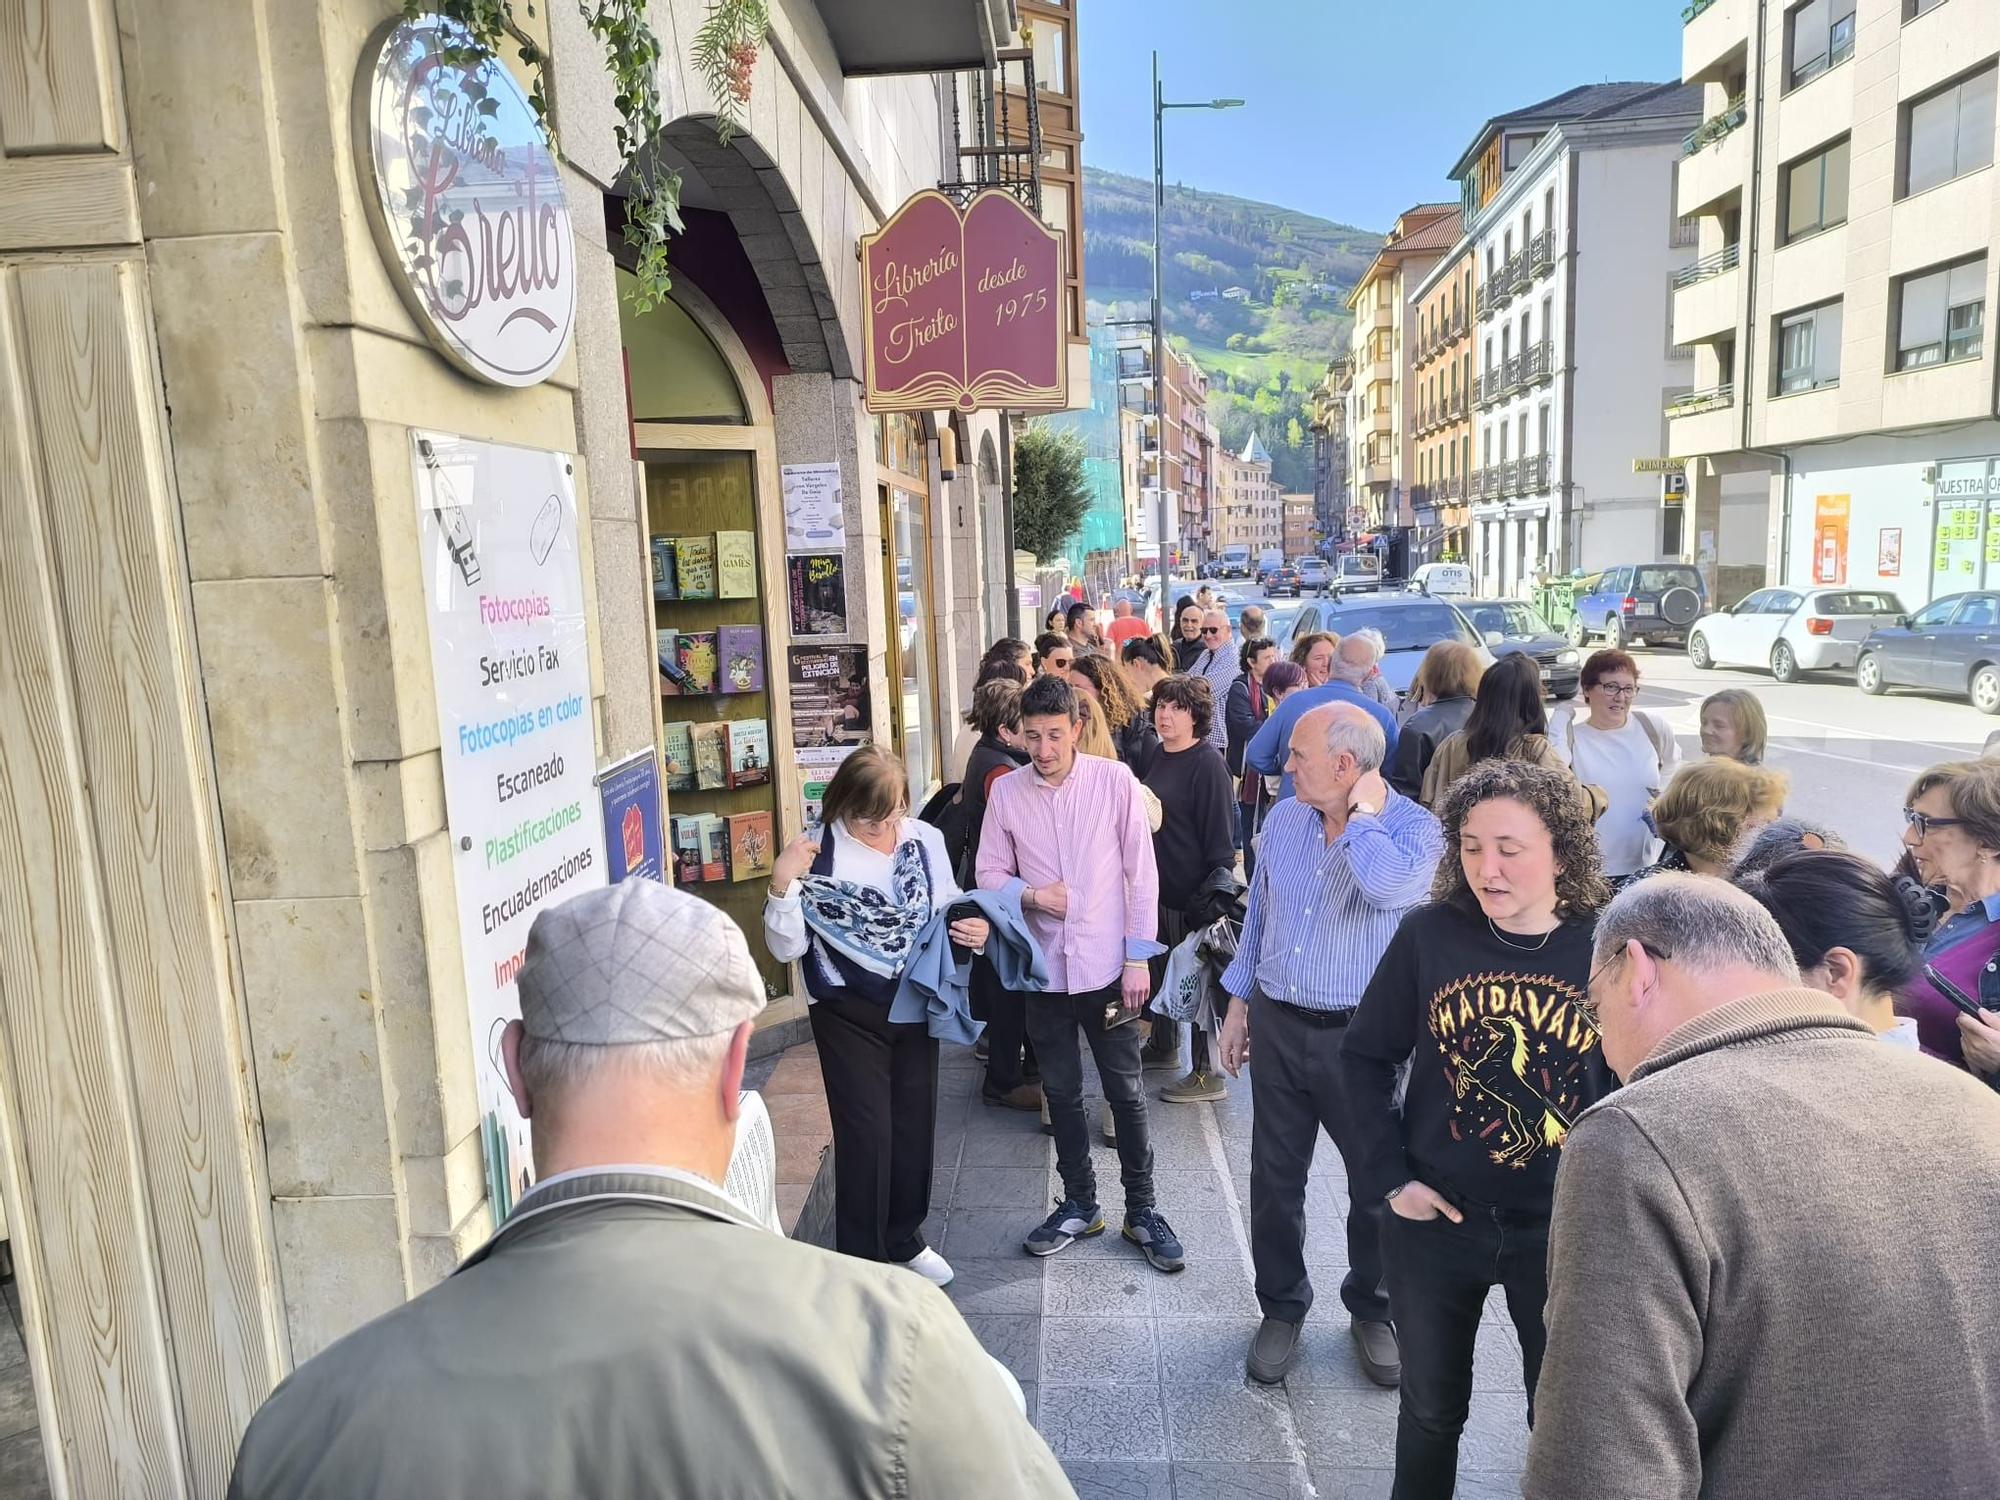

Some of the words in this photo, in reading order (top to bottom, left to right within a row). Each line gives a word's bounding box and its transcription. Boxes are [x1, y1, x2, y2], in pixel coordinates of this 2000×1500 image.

[874, 247, 958, 314] Librería
[978, 257, 1027, 293] desde
[995, 288, 1047, 326] 1975
[884, 308, 957, 364] Treito
[1670, 475, 1684, 493] P
[1937, 478, 1984, 494] NUESTRA
[723, 558, 751, 568] GAMES
[479, 591, 550, 625] Fotocopias
[480, 655, 535, 686] Servicio
[538, 645, 560, 673] Fax
[802, 662, 829, 671] PELIGRO
[459, 712, 534, 755] Fotocopias
[538, 709, 553, 729] en
[556, 694, 582, 723] color
[497, 752, 564, 803] Escaneado
[485, 800, 582, 870] Plastificaciones
[482, 846, 593, 935] Encuadernaciones
